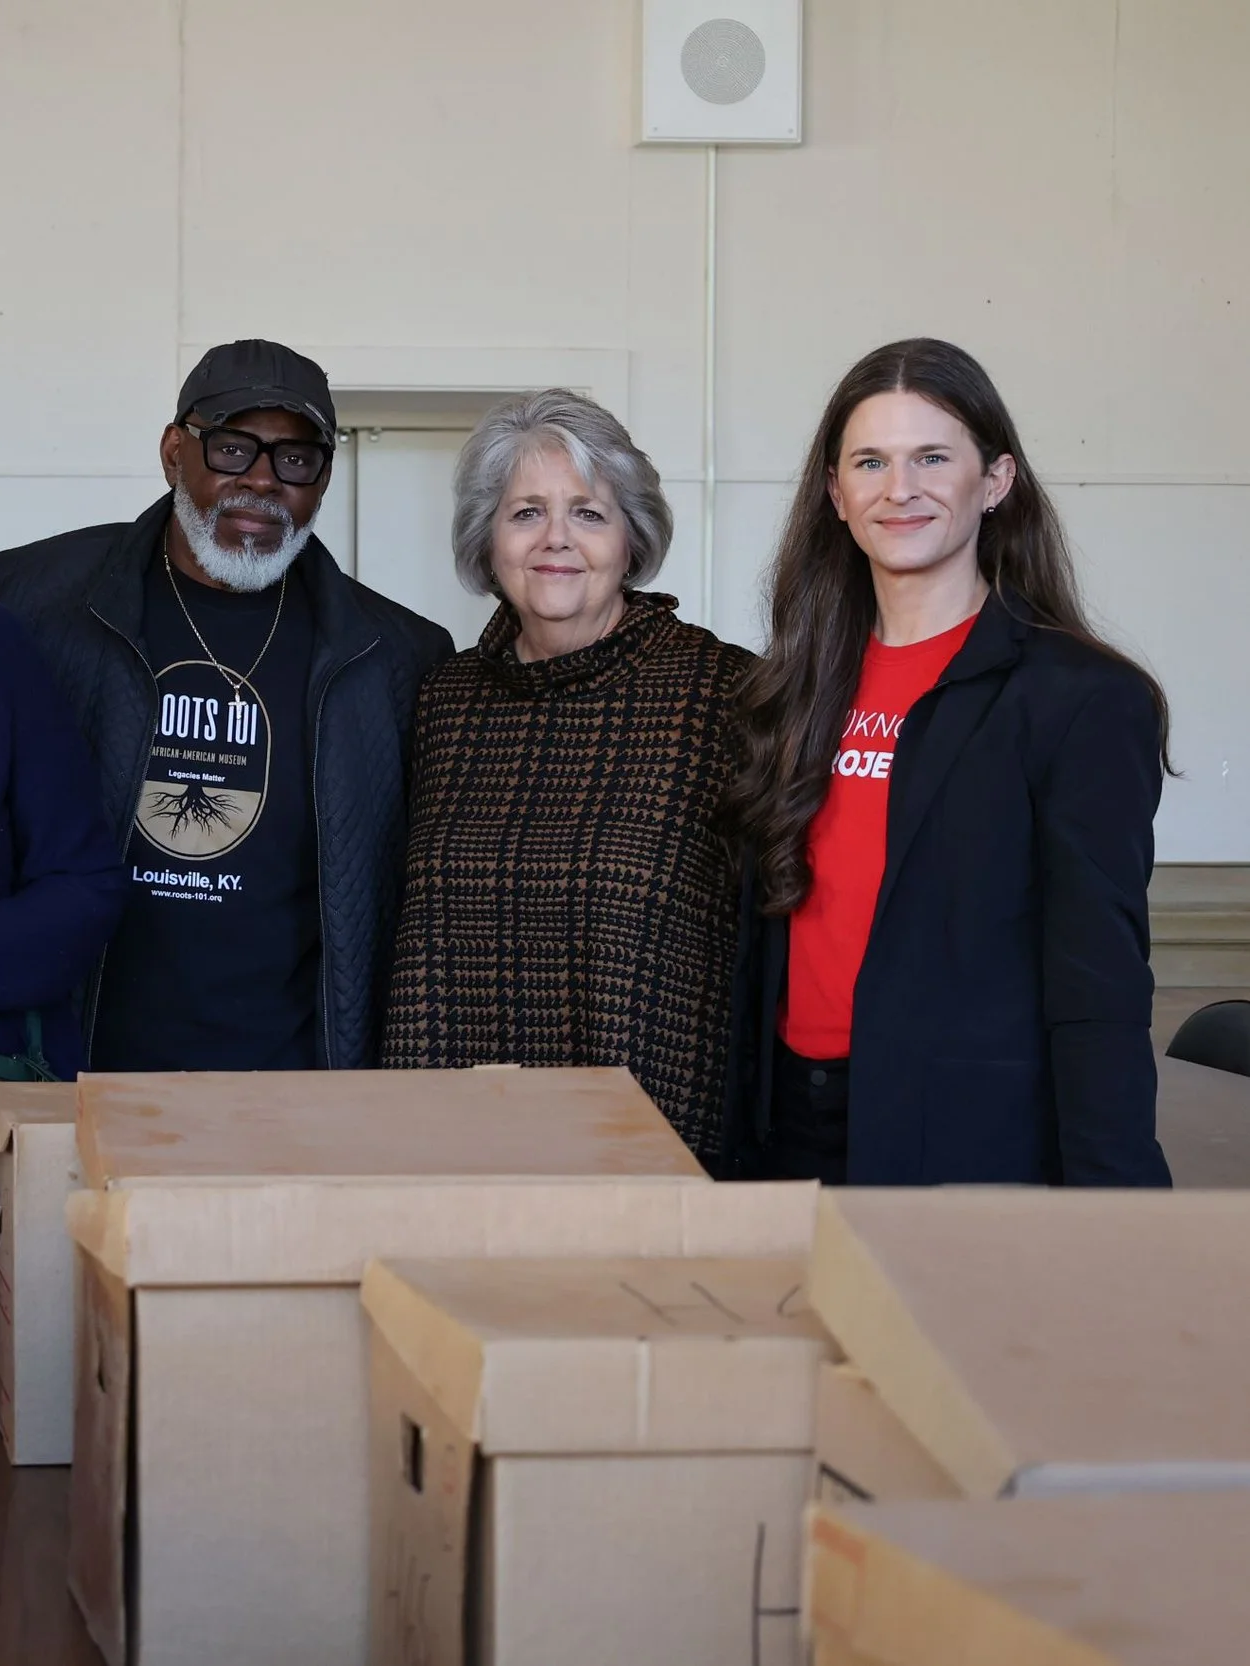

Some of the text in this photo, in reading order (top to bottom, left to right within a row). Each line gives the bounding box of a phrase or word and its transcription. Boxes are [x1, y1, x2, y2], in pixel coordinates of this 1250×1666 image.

[155, 693, 218, 741] OOTS
[151, 746, 247, 766] AFRICAN-AMERICAN MUSEUM
[168, 769, 226, 783] Legacies Matter
[132, 865, 243, 891] Louisville, KY.
[150, 889, 223, 903] www.roots-101.org
